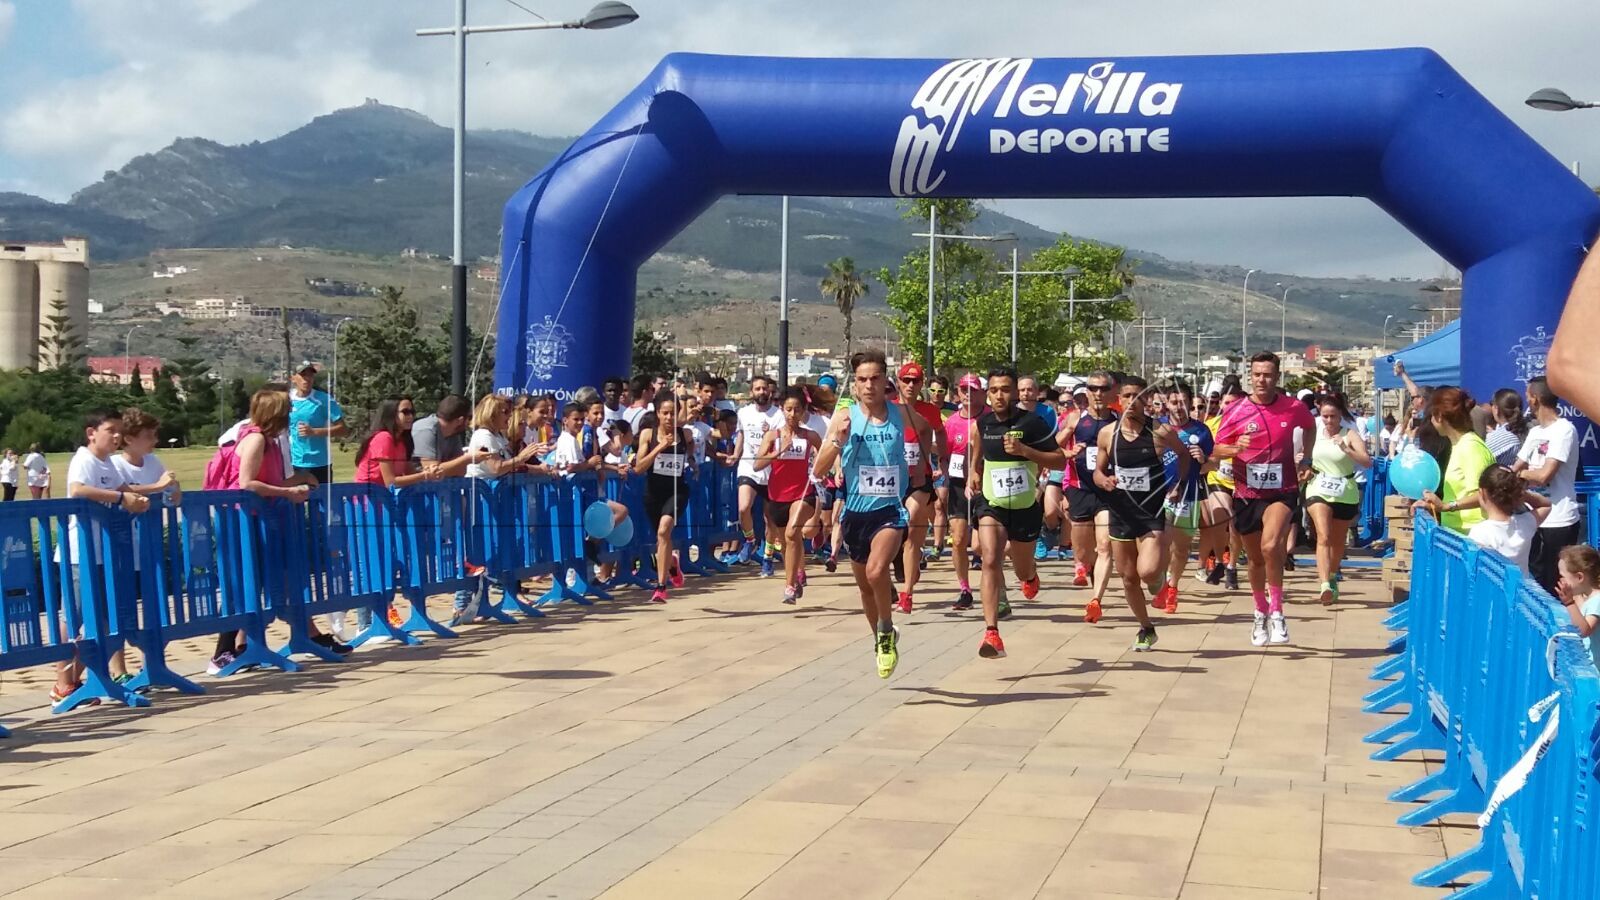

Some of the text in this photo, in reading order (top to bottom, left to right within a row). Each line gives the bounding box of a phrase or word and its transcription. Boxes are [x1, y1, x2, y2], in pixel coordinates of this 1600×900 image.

[911, 57, 1183, 118] Melilla
[990, 127, 1170, 154] DEPORTE
[659, 460, 681, 470] 146
[865, 476, 896, 488] 144
[997, 474, 1024, 489] 154
[1119, 475, 1145, 485] 375
[1252, 472, 1278, 482] 198
[1320, 479, 1341, 491] 227
